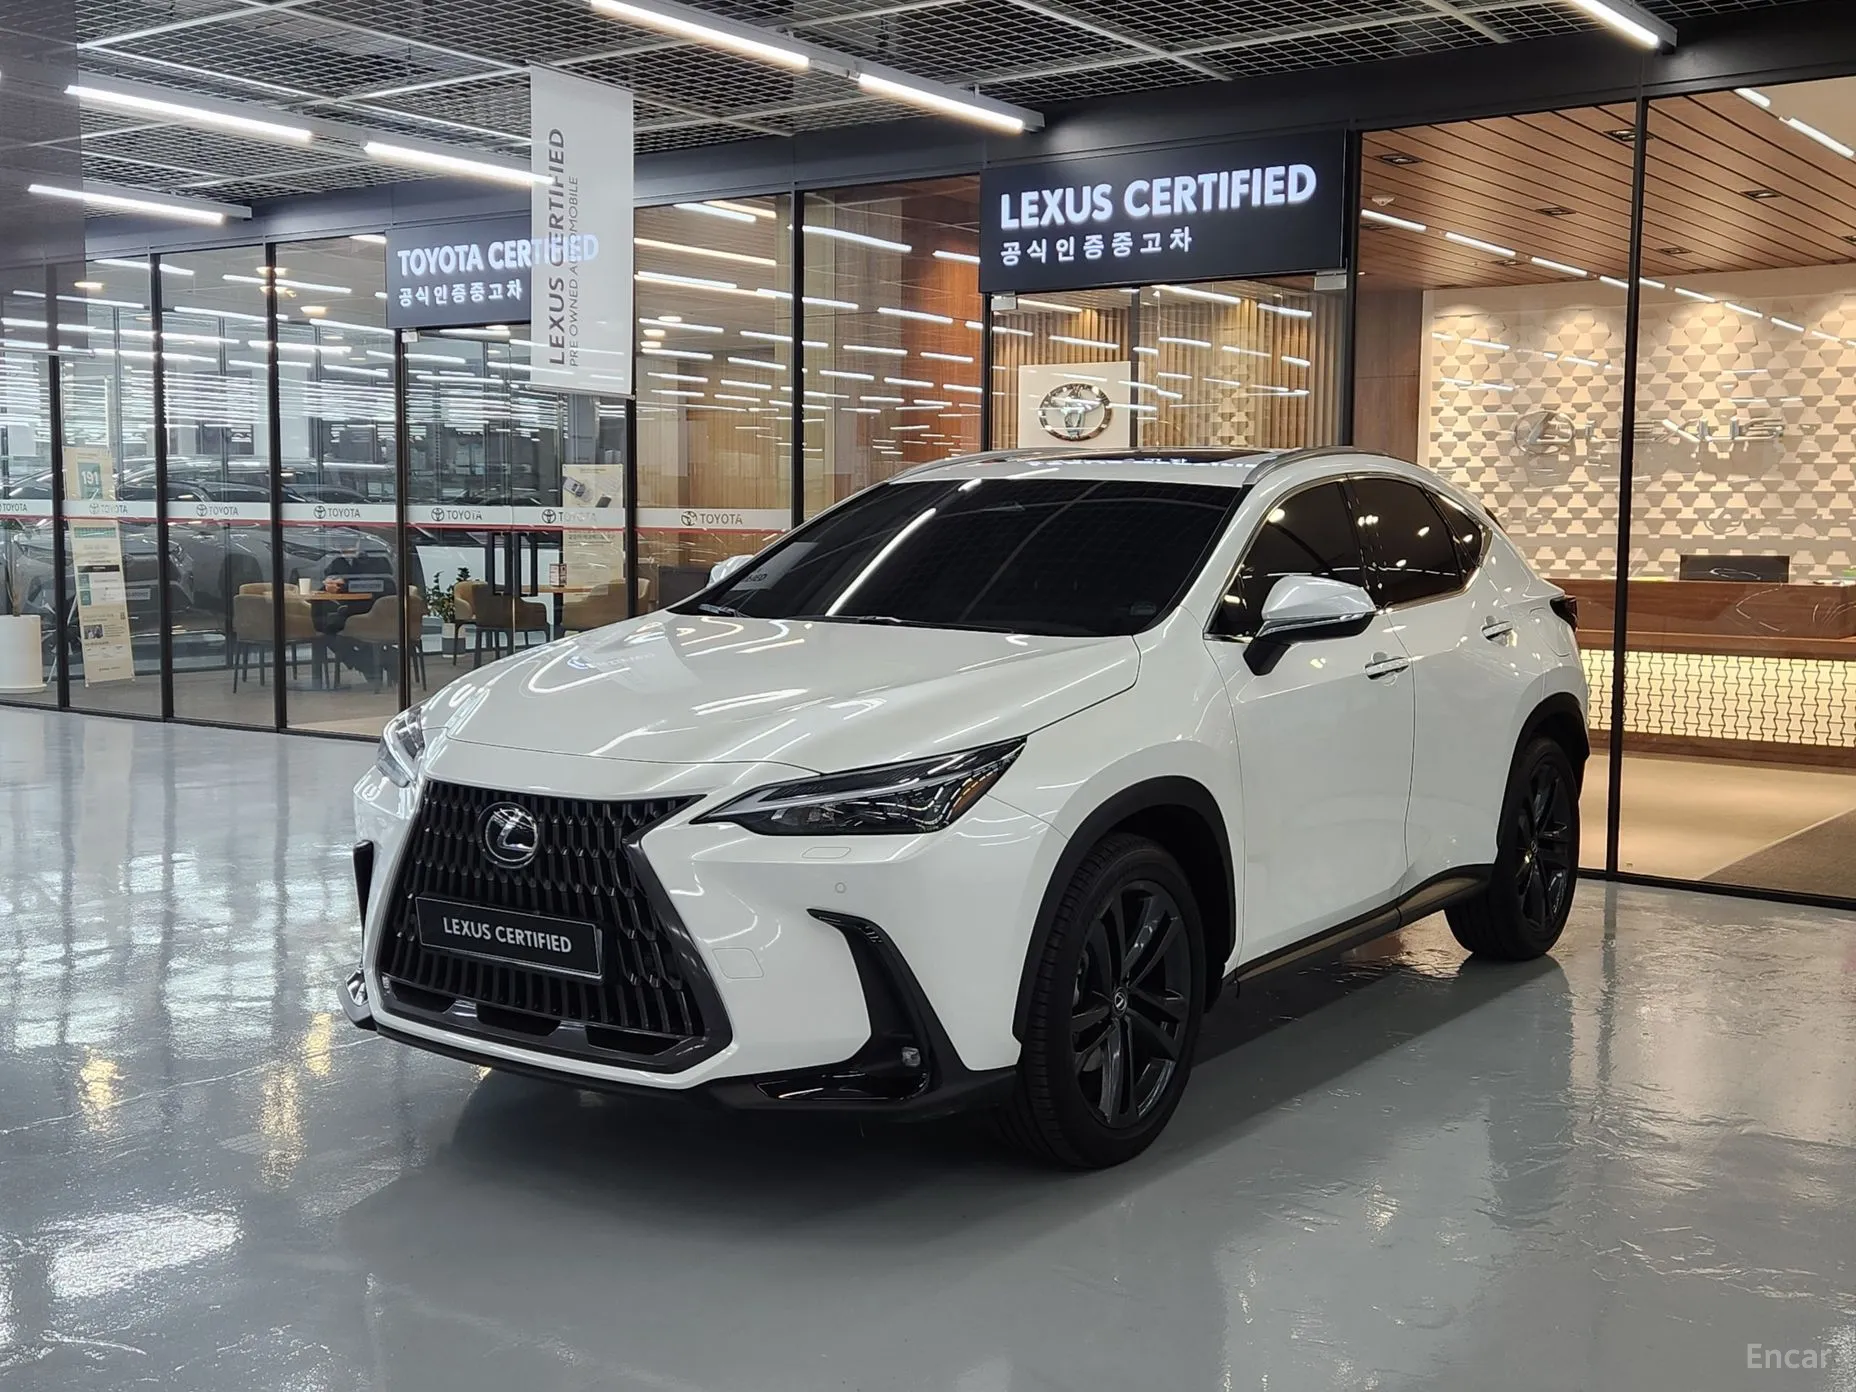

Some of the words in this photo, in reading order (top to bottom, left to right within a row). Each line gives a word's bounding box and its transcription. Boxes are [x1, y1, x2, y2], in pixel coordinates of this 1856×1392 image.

[548, 128, 565, 267] CERTIFIED
[1000, 183, 1113, 231] LEXUS
[1123, 163, 1317, 218] CERTIFIED
[397, 243, 485, 277] TOYOTA
[1000, 225, 1193, 266] 공식인증중고차
[398, 278, 523, 308] 공식인증중고차
[568, 279, 578, 334] OWNED
[548, 277, 565, 365] LEXUS
[569, 340, 578, 367] PRE
[2, 503, 28, 513] TOYOTA
[208, 506, 239, 516] TOYOTA
[327, 507, 361, 518] TOYOTA
[447, 510, 482, 520] TOYOTA
[700, 513, 743, 525] TOYOTA
[443, 917, 491, 940] LEXUS
[495, 926, 572, 953] CERTIFIED
